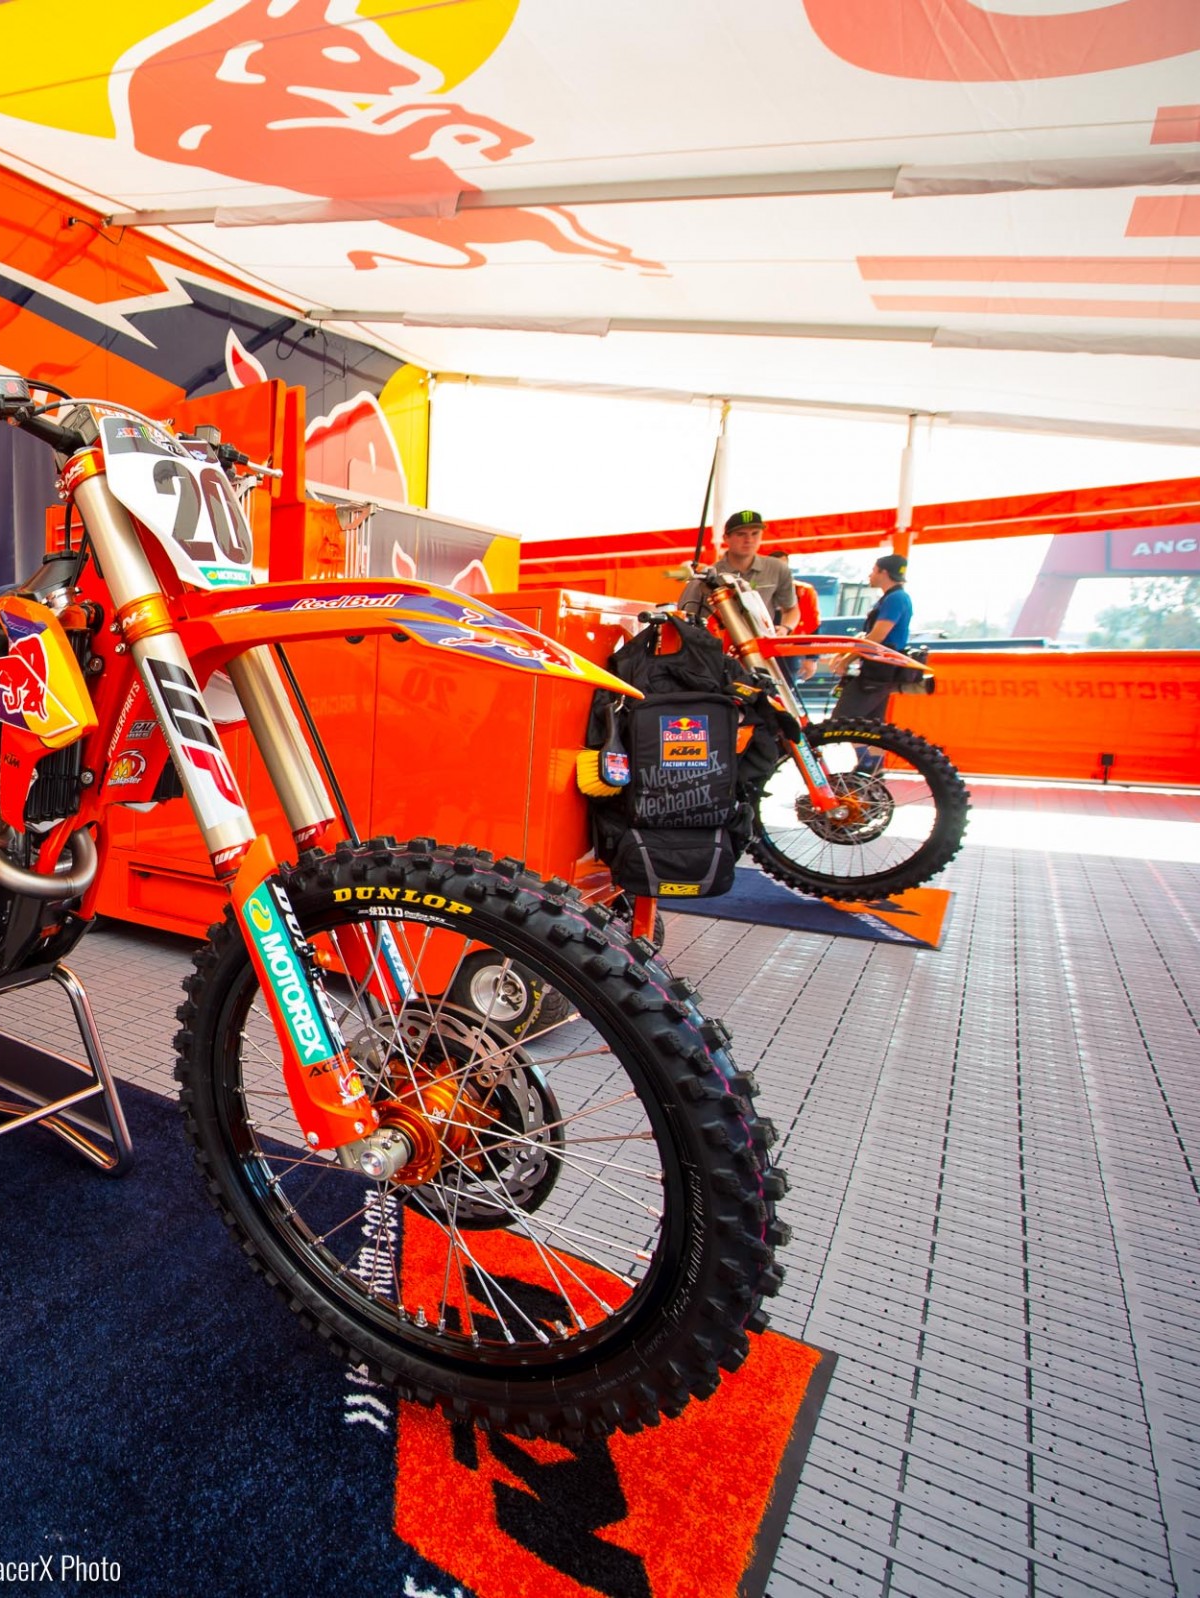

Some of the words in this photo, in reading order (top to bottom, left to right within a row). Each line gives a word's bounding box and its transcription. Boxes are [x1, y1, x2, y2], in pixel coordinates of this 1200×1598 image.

[153, 460, 252, 564] 20
[1132, 538, 1198, 556] ANG
[290, 595, 349, 611] Red
[341, 594, 404, 608] Bull
[107, 680, 140, 758] POWERPARTS
[663, 731, 684, 741] Red
[686, 730, 706, 741] Bull
[823, 730, 881, 740] DUNLOP
[669, 746, 701, 756] KTM
[333, 887, 472, 915] DUNLOP
[260, 932, 326, 1061] MOTOREX
